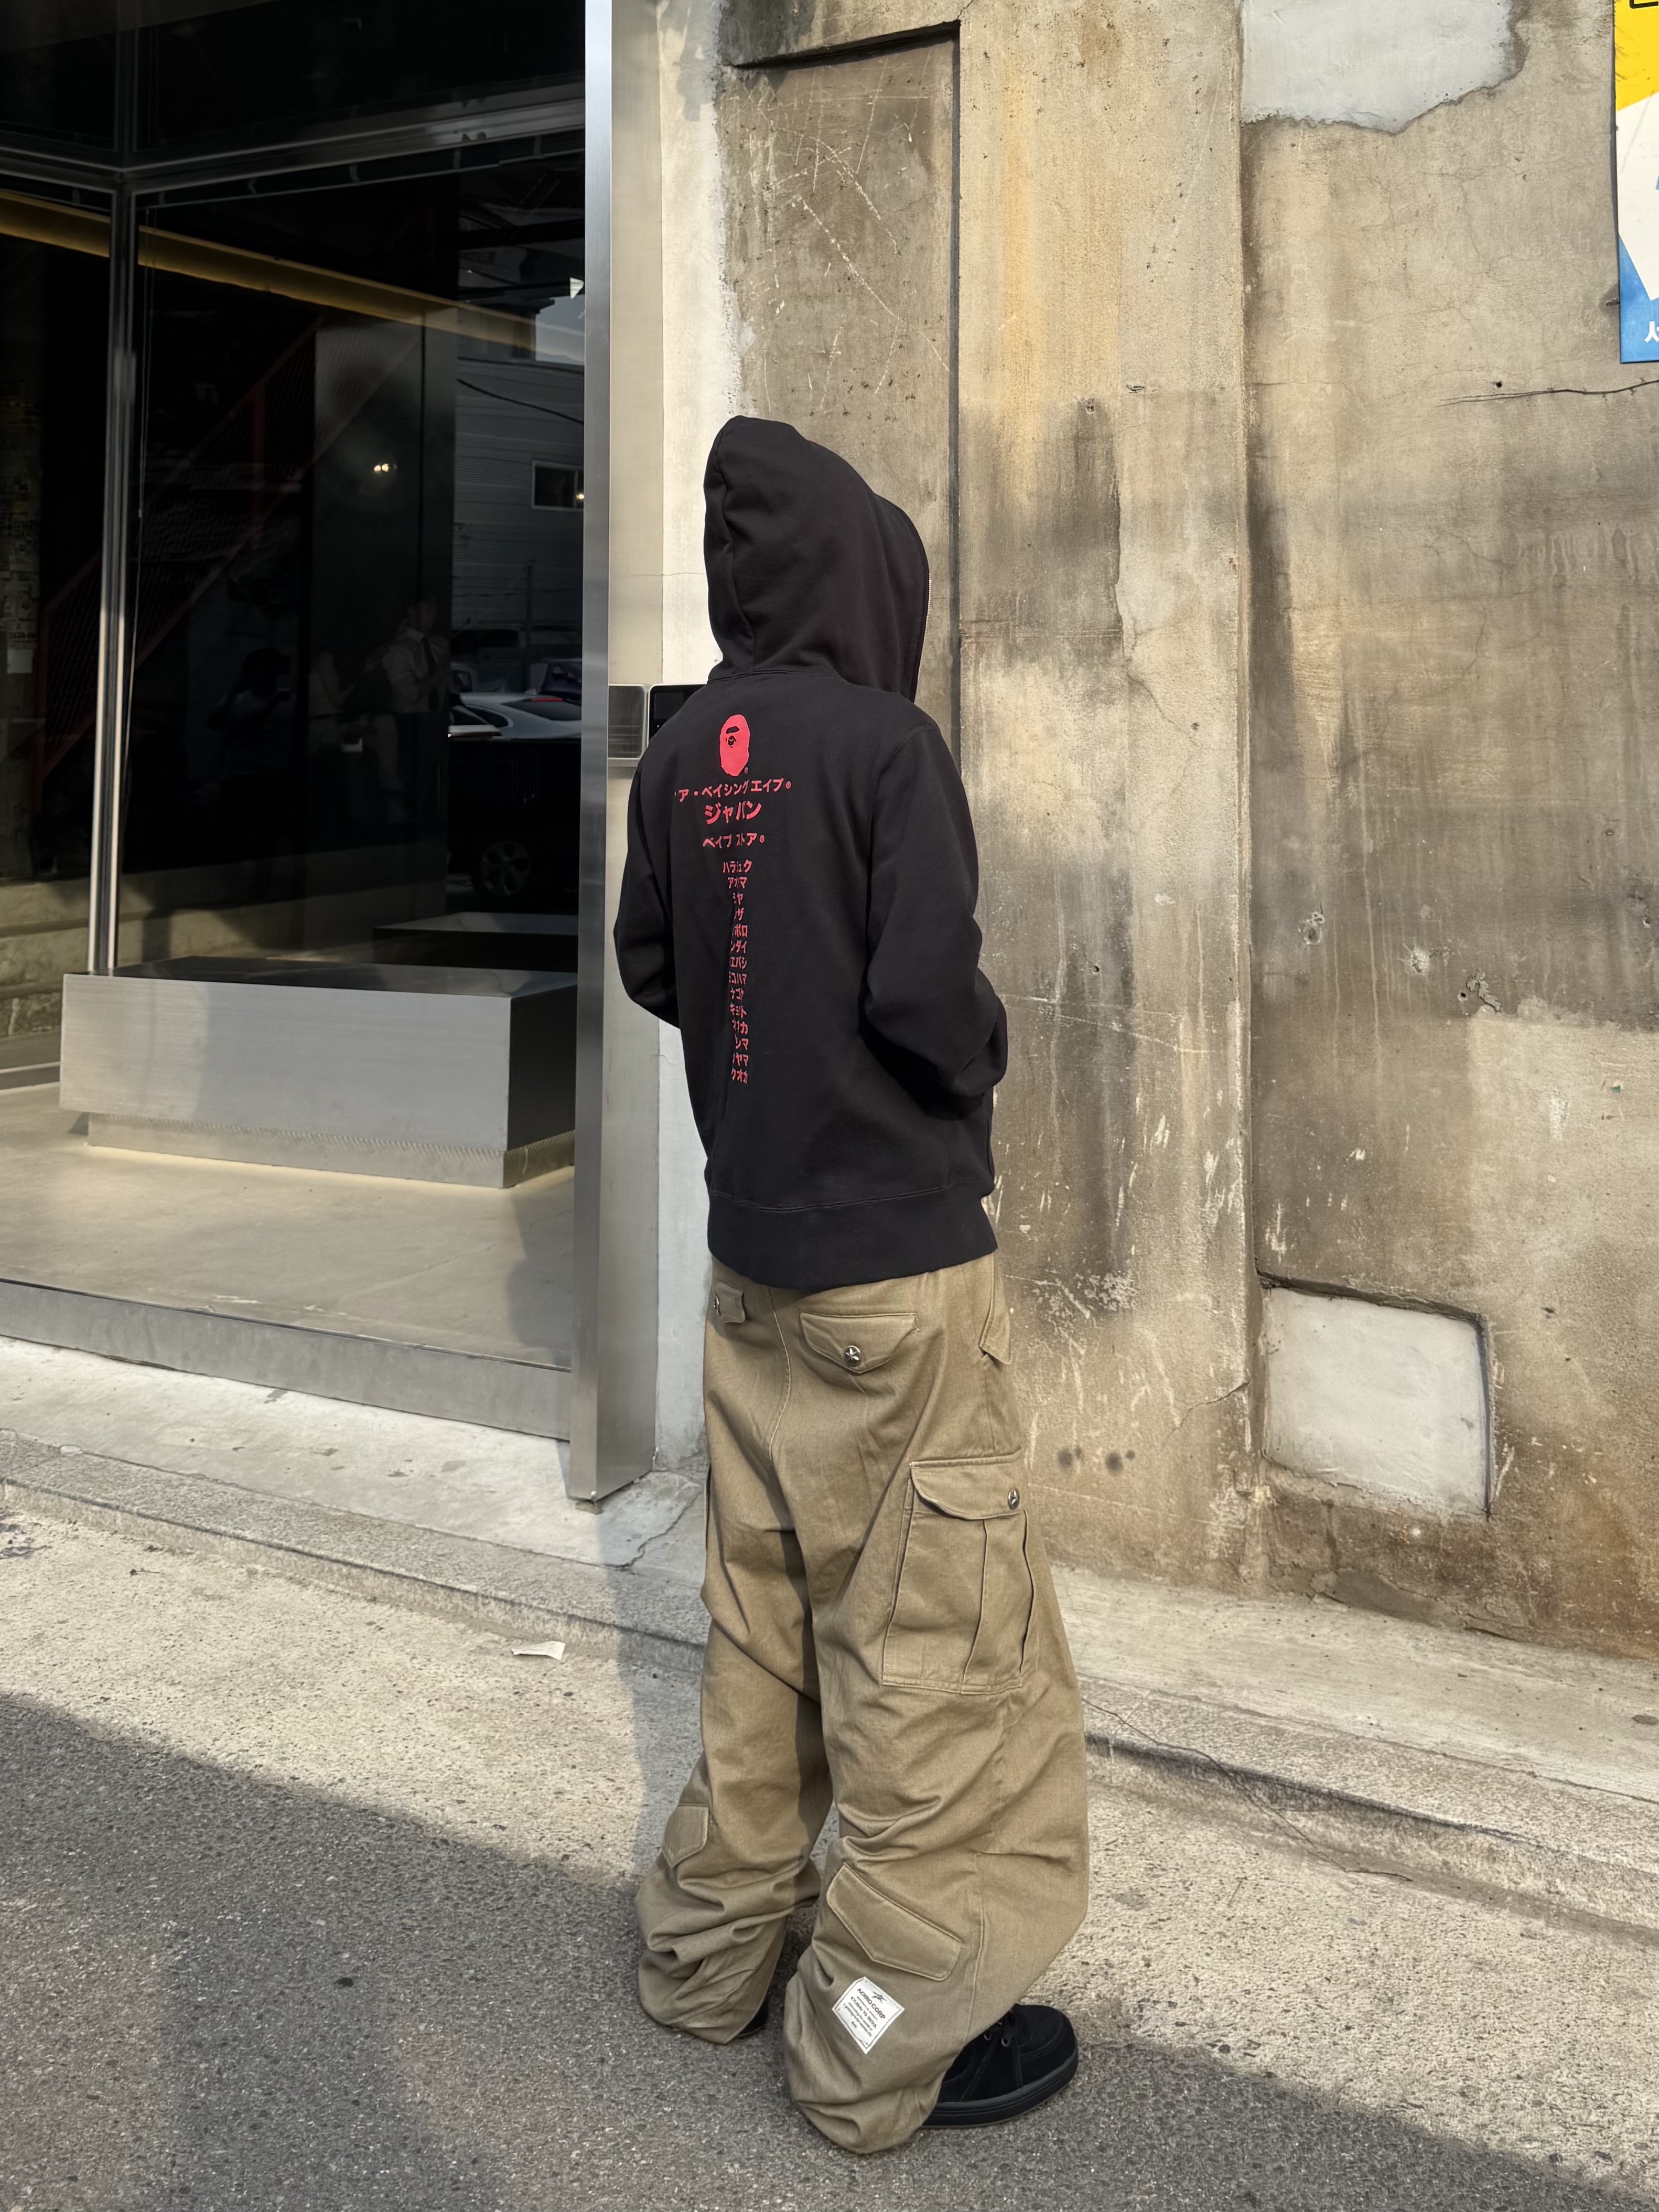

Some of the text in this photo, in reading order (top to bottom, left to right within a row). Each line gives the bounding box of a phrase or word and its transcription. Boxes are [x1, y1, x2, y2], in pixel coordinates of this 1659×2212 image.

[705, 801, 761, 824] ジャパン
[871, 2003, 886, 2019] CORP
